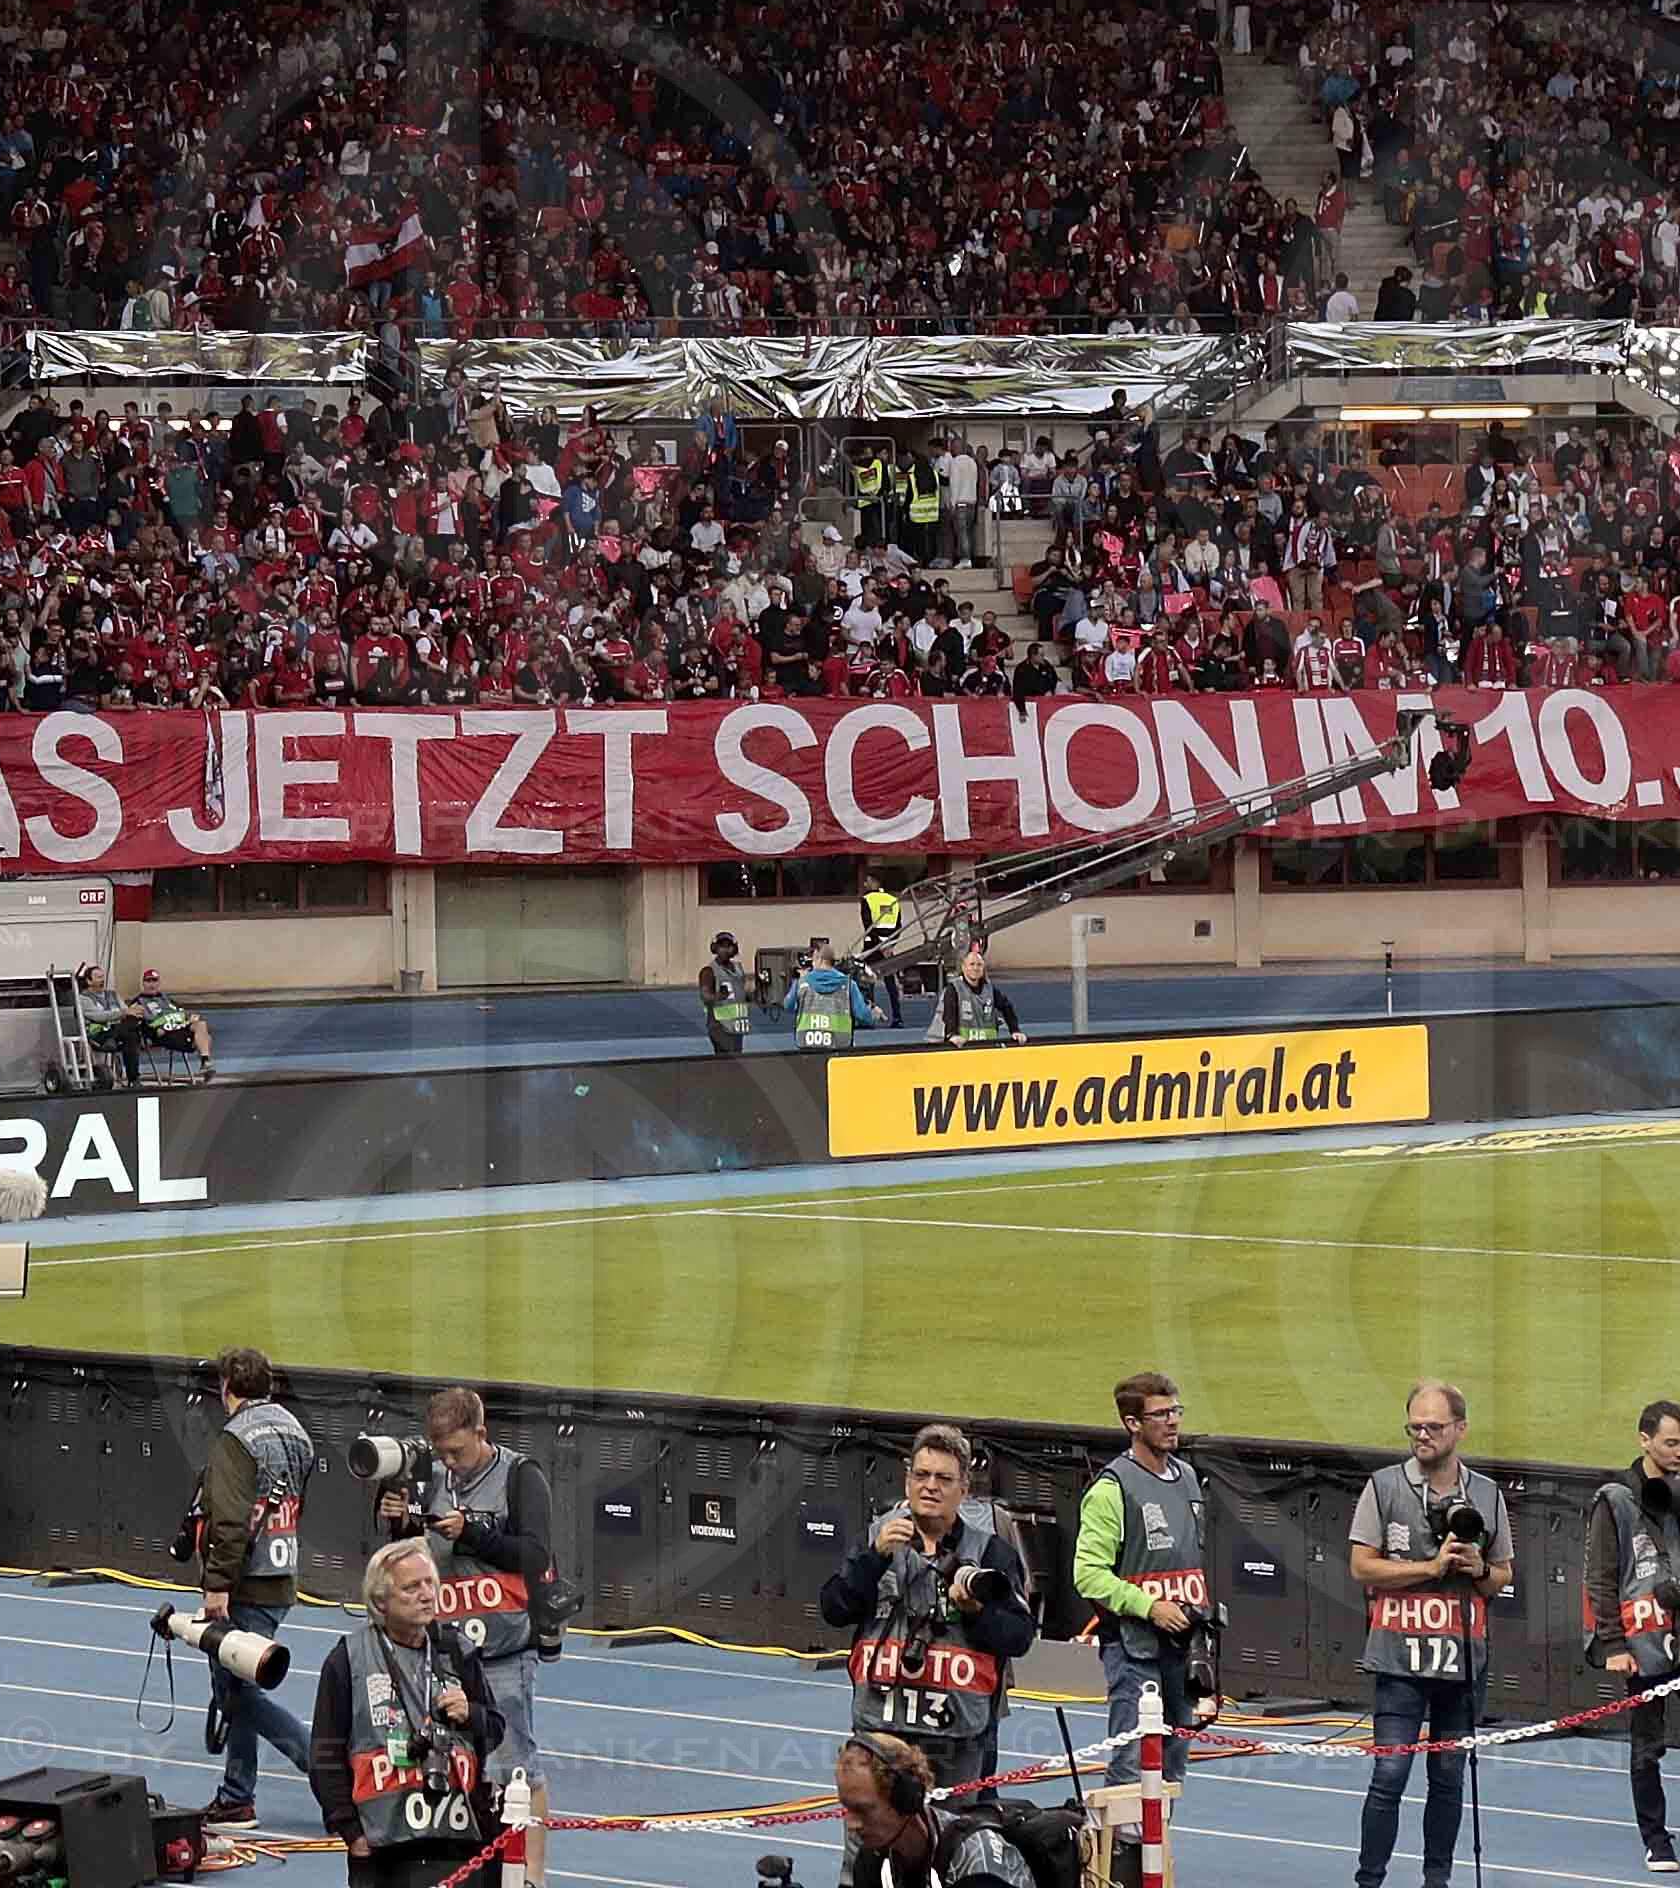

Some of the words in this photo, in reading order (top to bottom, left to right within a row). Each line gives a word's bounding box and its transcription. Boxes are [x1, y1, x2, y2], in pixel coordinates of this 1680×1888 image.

[166, 709, 668, 857] JETZT
[714, 700, 1277, 854] SCHON
[1292, 694, 1462, 826] IM
[80, 891, 105, 903] ORF
[810, 1014, 830, 1029] HB
[913, 1046, 1358, 1137] www.admiral.at
[690, 1524, 736, 1539] VIDEOWALL
[1406, 1637, 1459, 1673] 112
